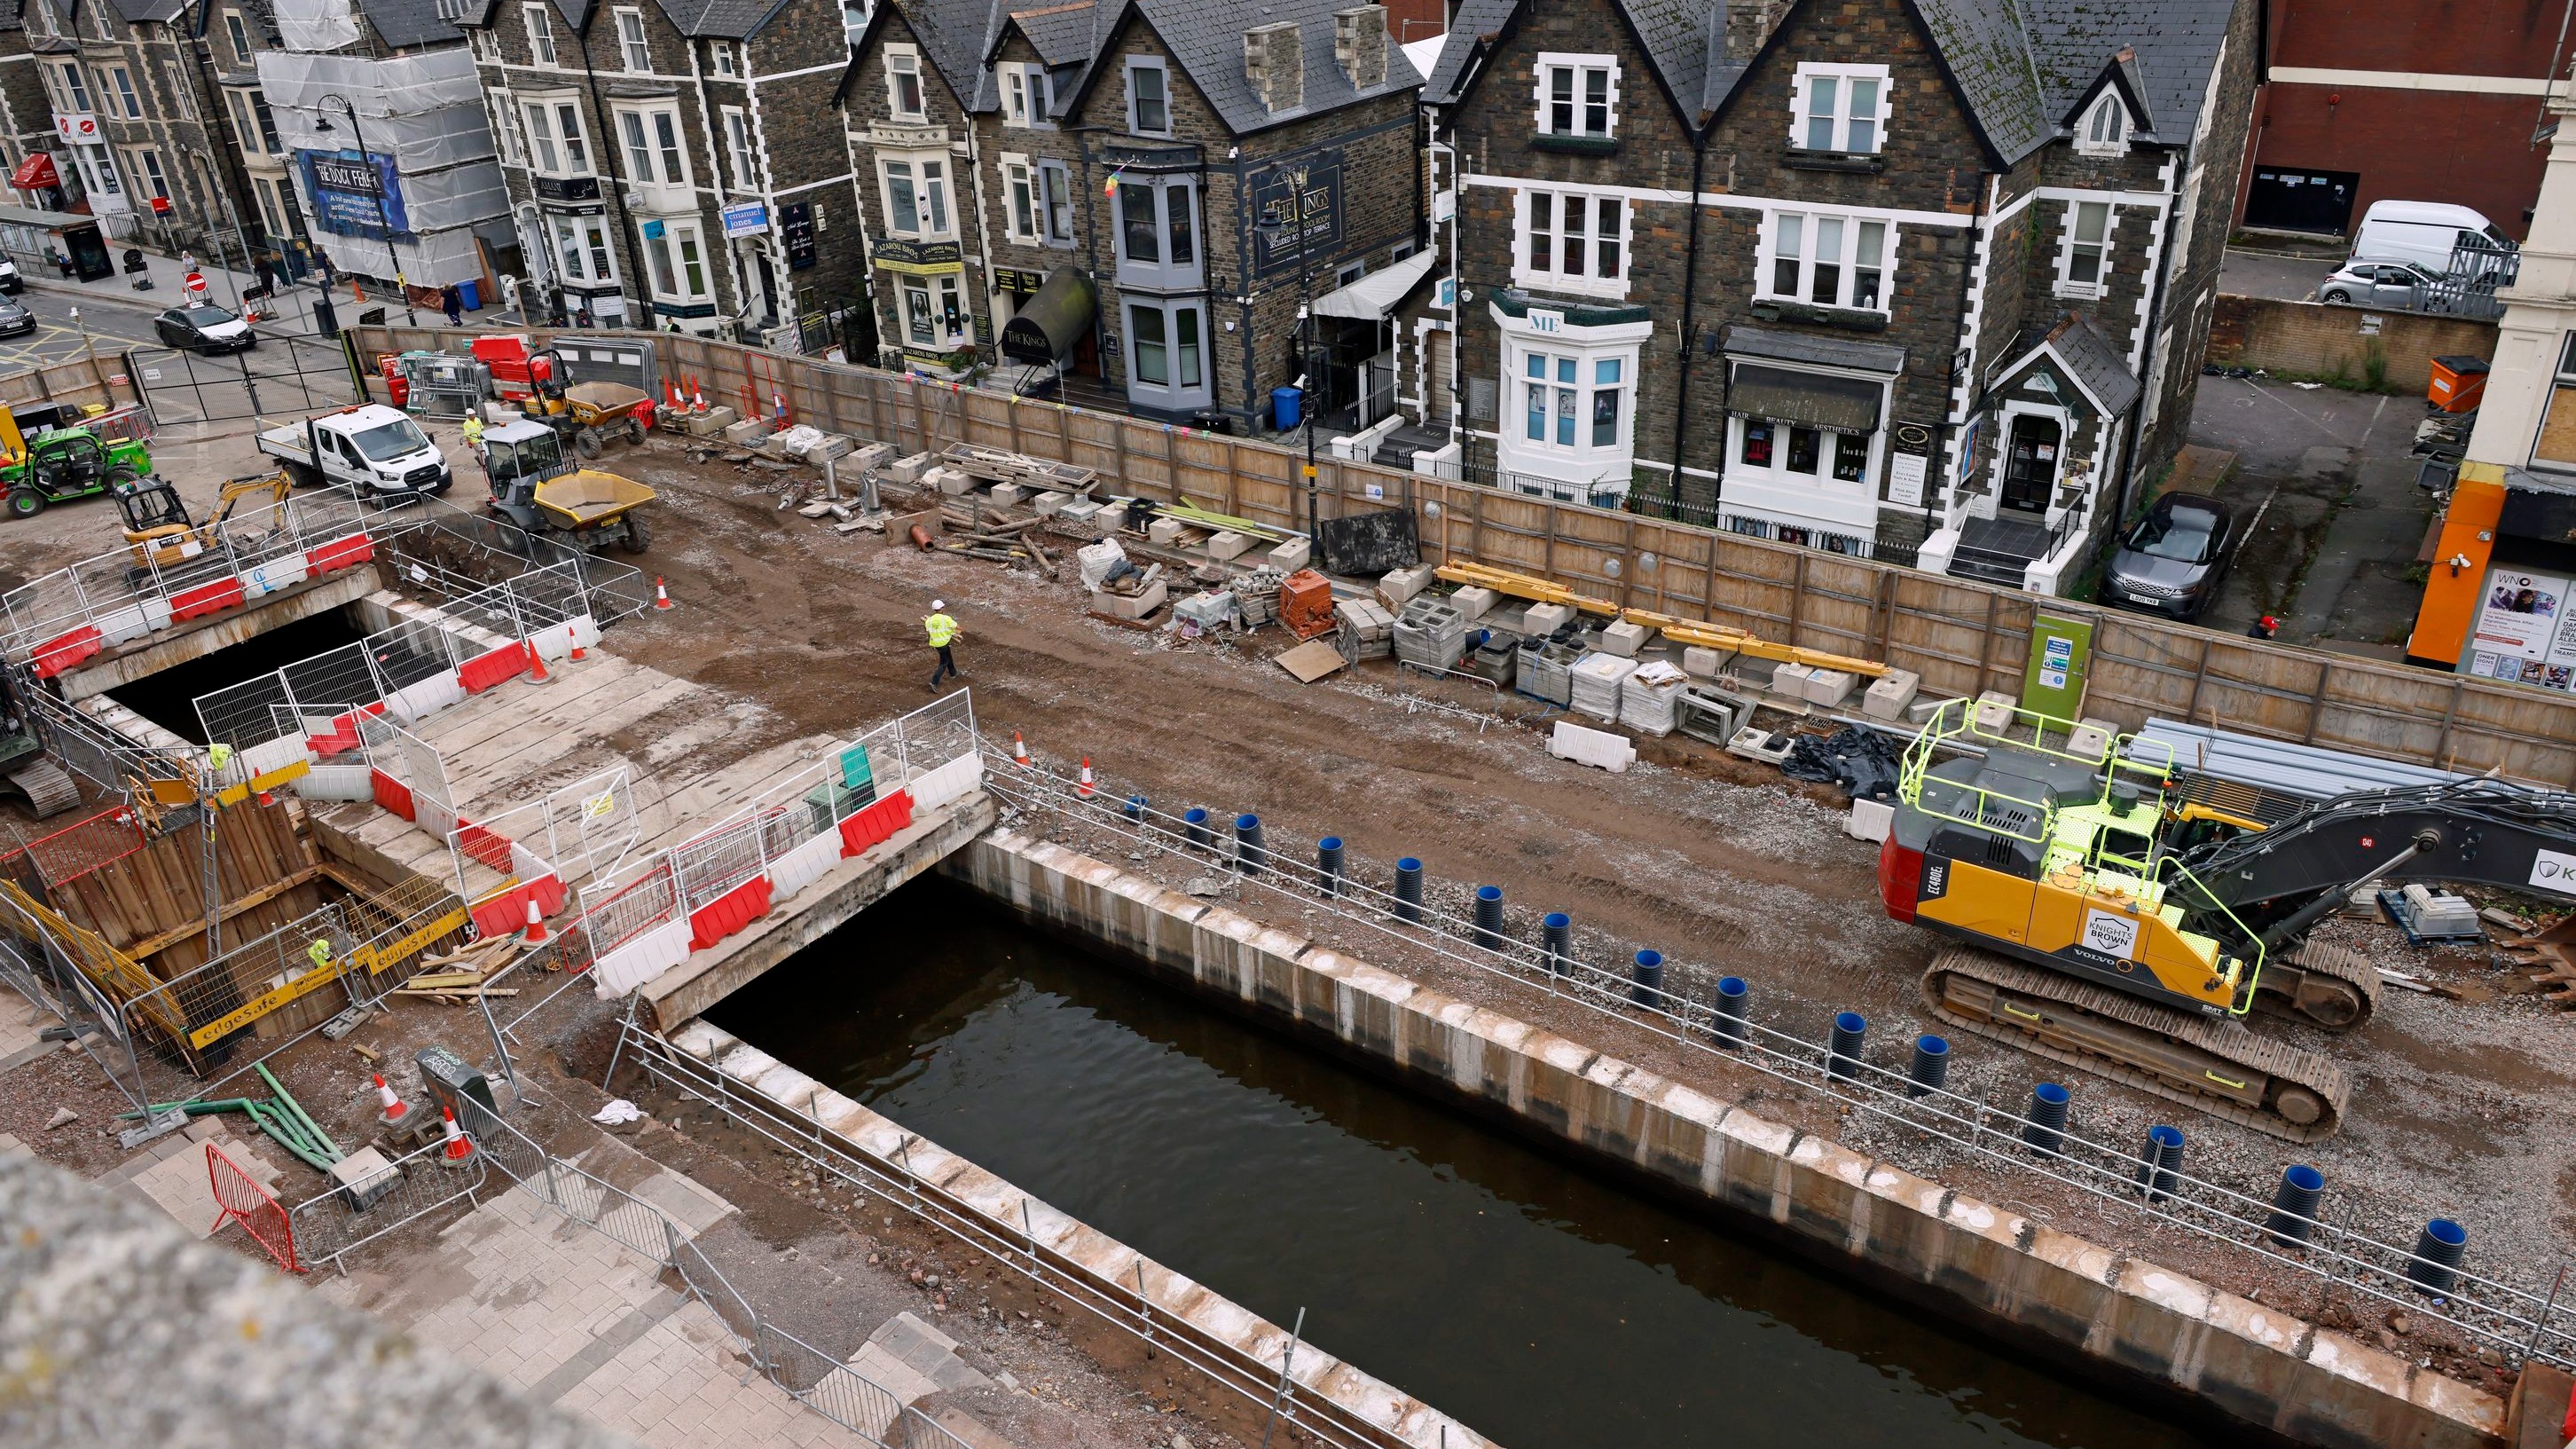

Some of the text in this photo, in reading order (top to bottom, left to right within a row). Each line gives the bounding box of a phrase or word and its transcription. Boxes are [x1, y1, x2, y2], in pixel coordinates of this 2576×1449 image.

[330, 169, 351, 185] DOCK
[541, 181, 562, 192] AMANI
[728, 208, 760, 220] emanuel
[1315, 214, 1331, 224] ROOM
[730, 218, 752, 230] jones
[1268, 236, 1292, 249] SECLUDED
[1313, 222, 1331, 233] TERRACE
[876, 242, 919, 260] LAZAROU BROS
[922, 246, 944, 256] LAZAROU
[1443, 282, 1453, 292] ME
[1437, 320, 1442, 329] 8
[1530, 314, 1560, 333] ME
[1006, 330, 1047, 348] THE KINGS
[904, 347, 925, 358] LAZAROU
[1732, 410, 1749, 420] HAIR
[1766, 416, 1797, 427] BEAUTY
[1813, 423, 1860, 437] AESTHETICS
[2498, 574, 2531, 587] WNO
[2089, 921, 2132, 940] KNIGHTS
[2091, 929, 2129, 947] BROWN
[2073, 948, 2116, 965] VOLVO
[2202, 1004, 2223, 1014] SMT
